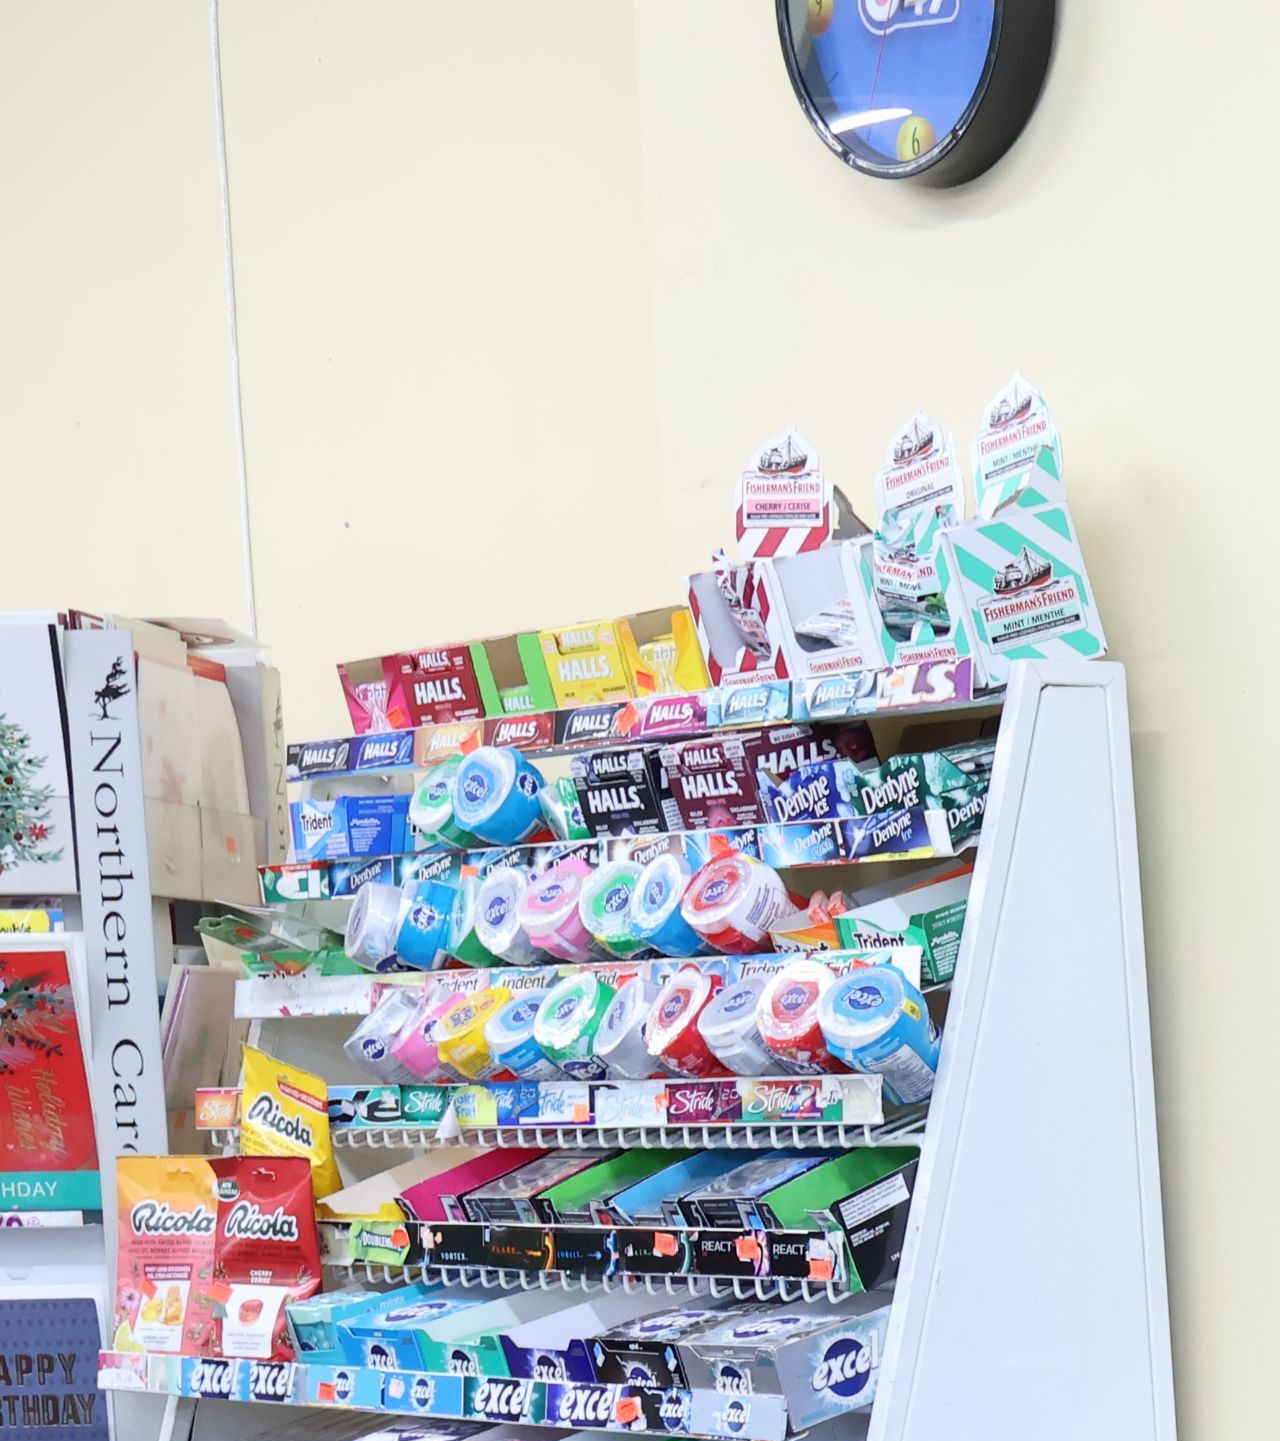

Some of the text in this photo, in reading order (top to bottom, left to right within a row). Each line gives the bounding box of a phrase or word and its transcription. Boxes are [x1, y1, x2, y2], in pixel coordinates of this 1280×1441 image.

[912, 127, 920, 156] 6
[755, 502, 811, 511] CHERRY CERISE
[1003, 620, 1024, 632] MINT
[1031, 608, 1064, 626] MENTHE
[88, 730, 137, 1011] Northern
[247, 1094, 313, 1147] Ricola
[131, 1201, 217, 1236] Ricola
[224, 1201, 299, 1240] Ricola
[701, 1241, 732, 1253] REACT
[812, 1332, 879, 1392] excel
